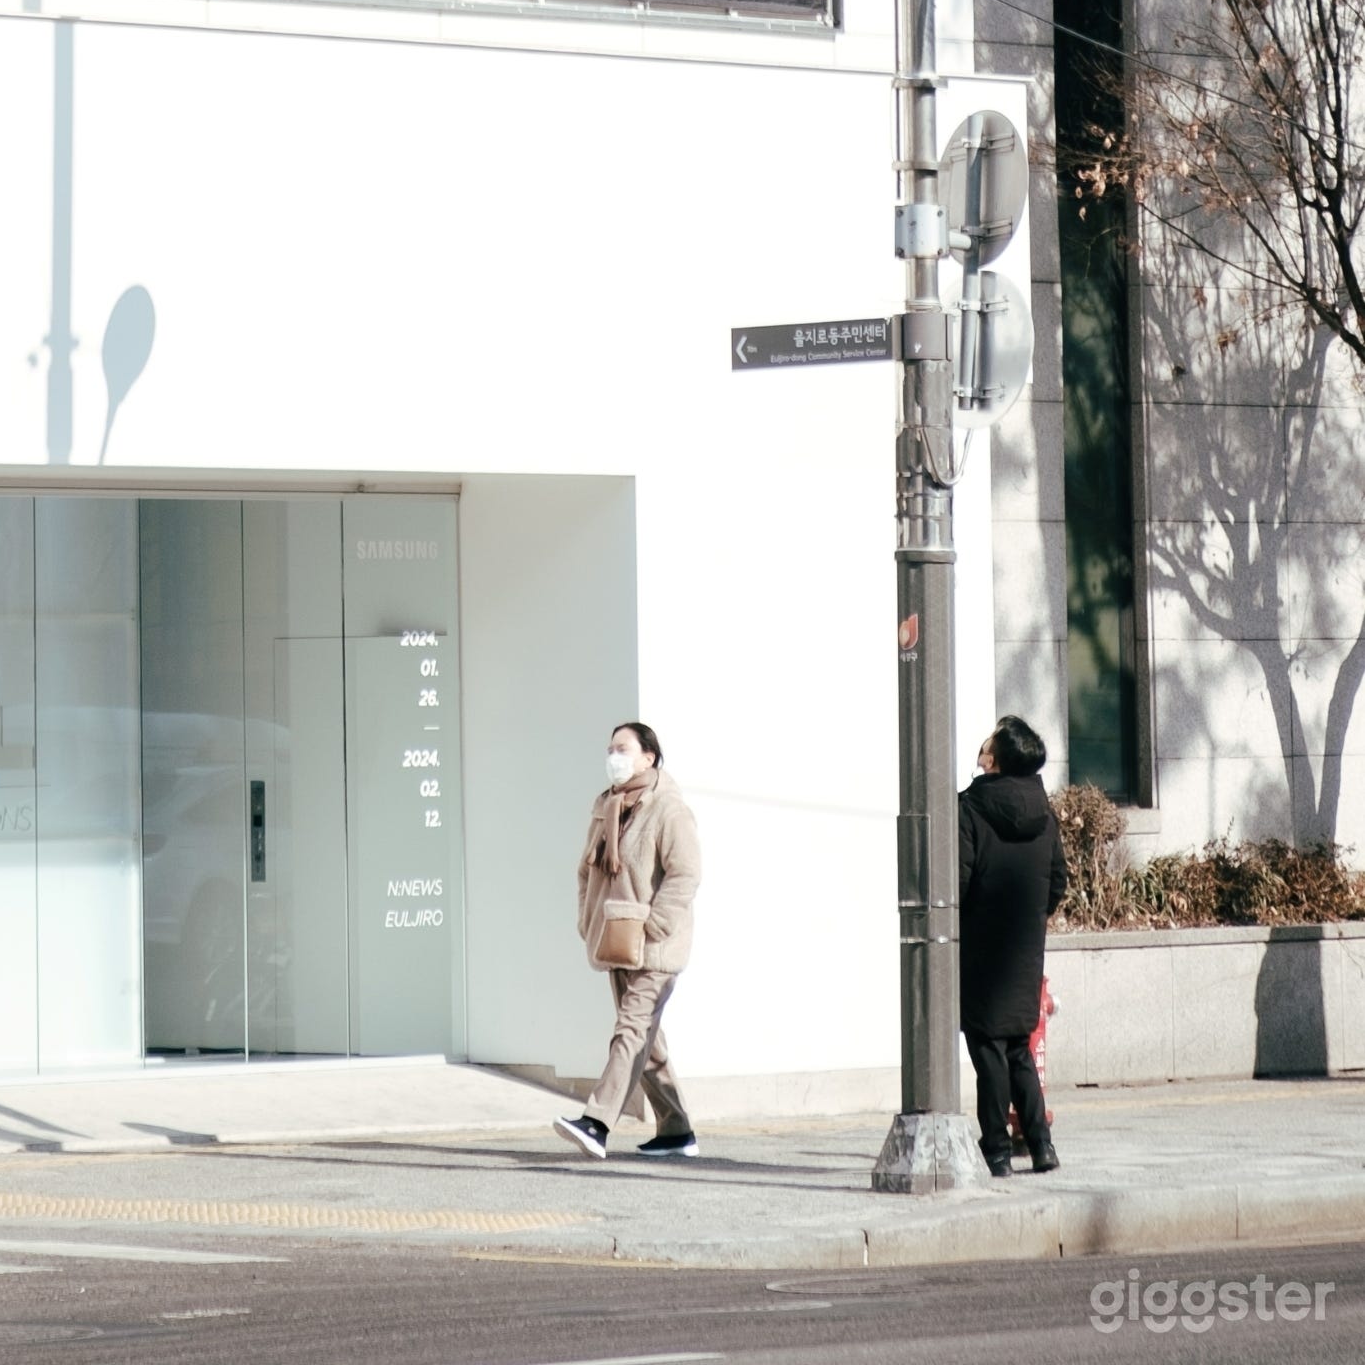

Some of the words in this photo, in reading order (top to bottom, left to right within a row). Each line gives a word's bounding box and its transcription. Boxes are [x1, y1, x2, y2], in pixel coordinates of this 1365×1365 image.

[793, 322, 886, 348] 을지로동주민센터
[356, 539, 439, 561] SAMSUNG
[400, 629, 439, 648] 2024.
[420, 658, 439, 677] 01.
[418, 689, 440, 707] 26.
[402, 749, 441, 768] 2024.
[419, 779, 441, 797] 02.
[425, 809, 442, 828] 12.
[387, 878, 443, 897] N:NEWS
[384, 908, 444, 928] EULJIRO
